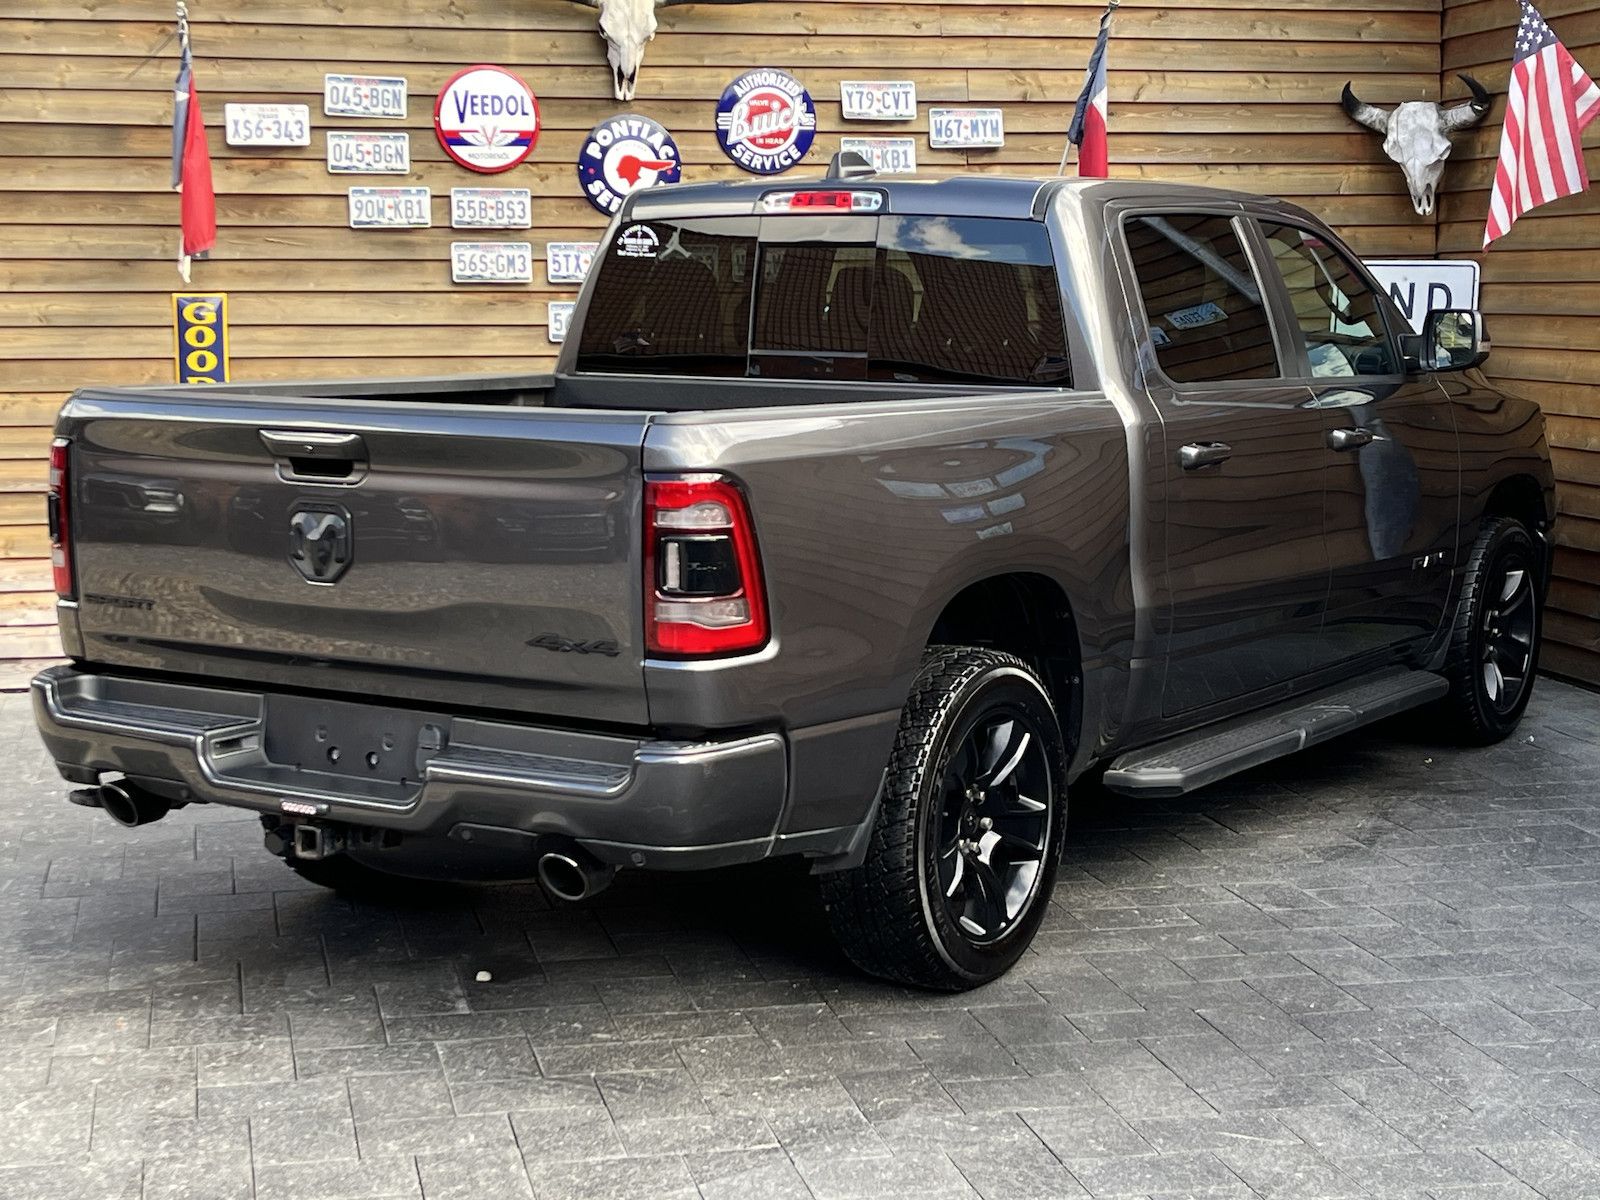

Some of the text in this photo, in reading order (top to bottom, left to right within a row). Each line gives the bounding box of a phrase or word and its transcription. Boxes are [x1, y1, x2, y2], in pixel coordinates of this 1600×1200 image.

[733, 71, 804, 98] AUTHORIZED
[453, 90, 529, 124] VEEDOL
[727, 95, 810, 145] Buick
[586, 119, 675, 160] PONTIAC
[731, 143, 802, 171] SERVICE
